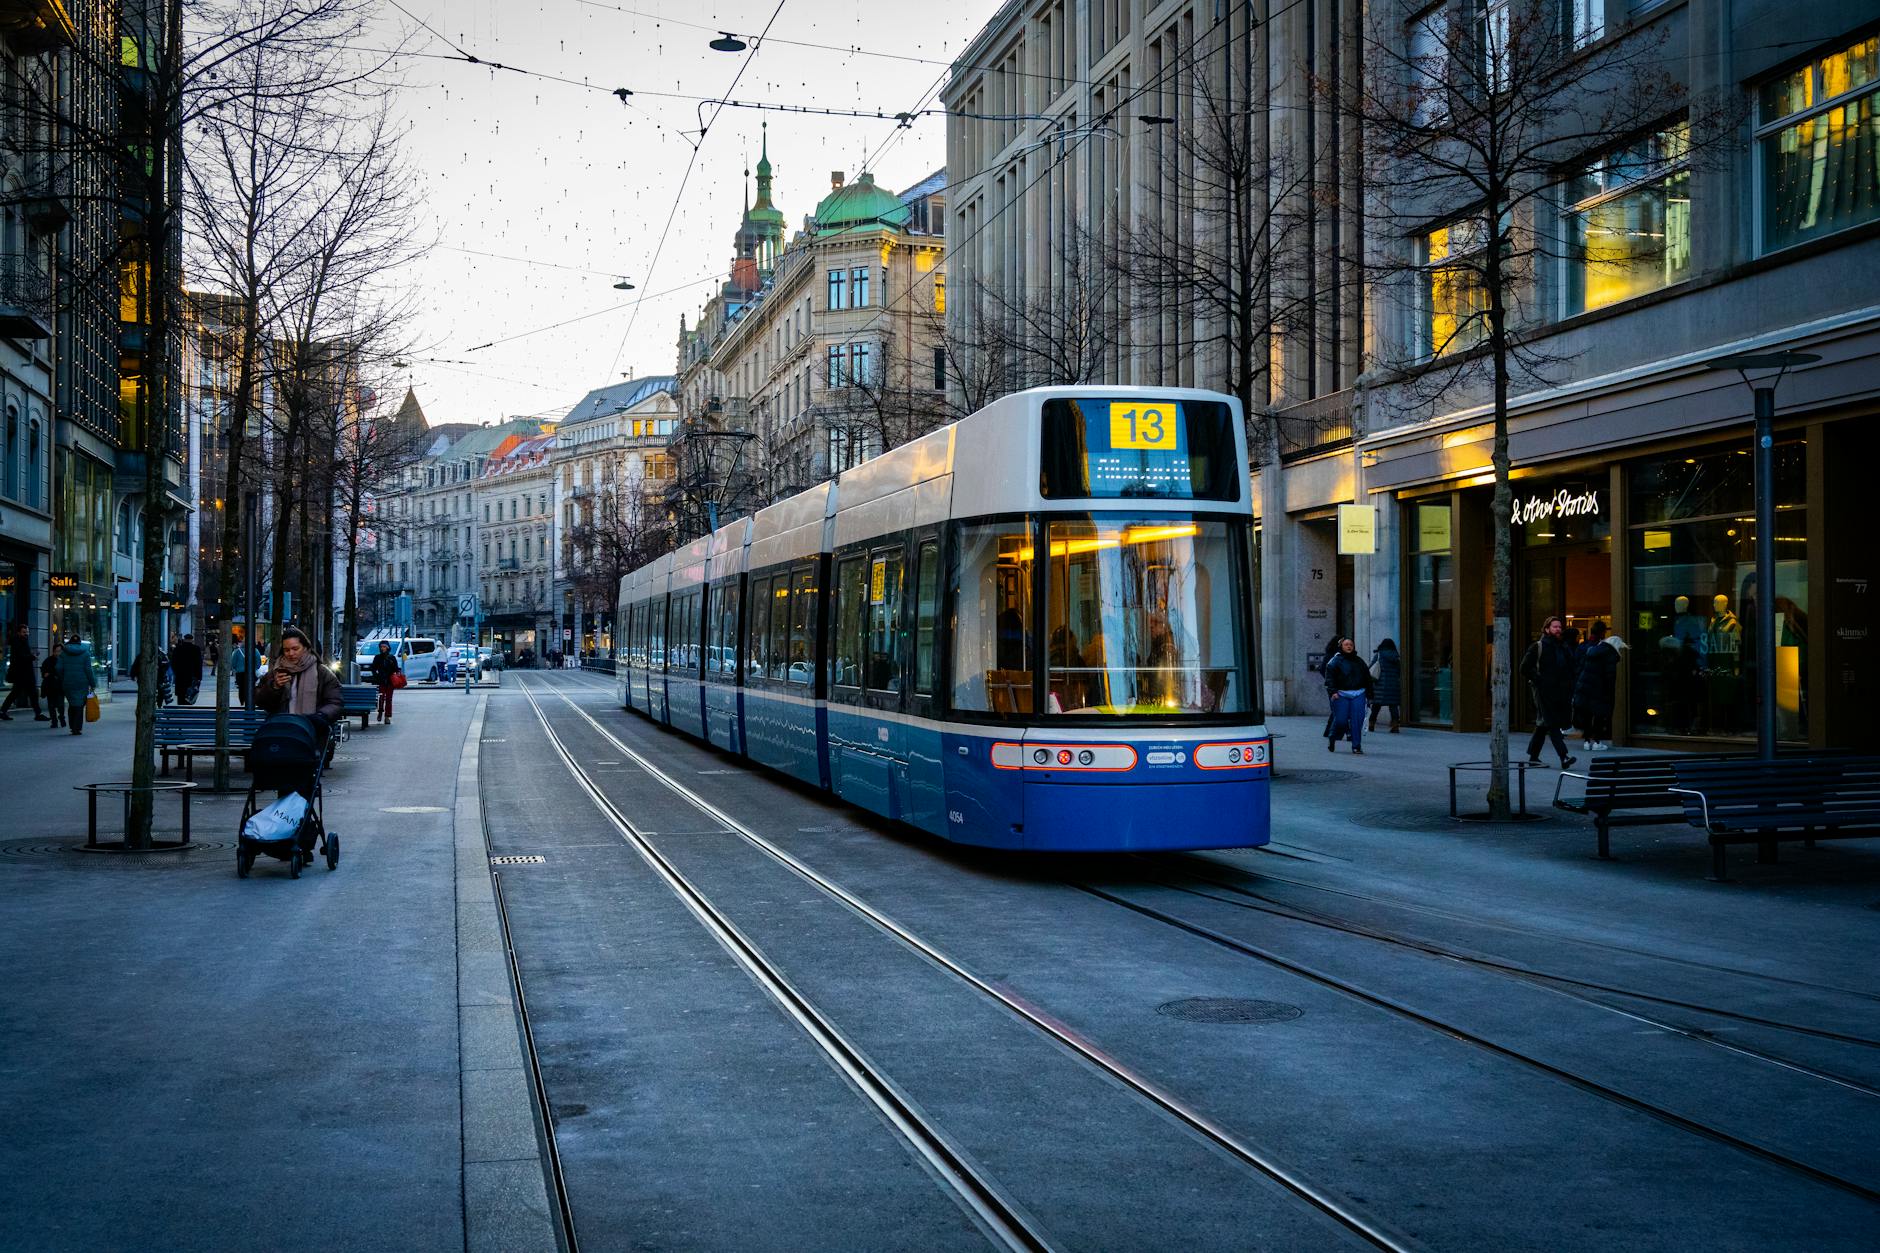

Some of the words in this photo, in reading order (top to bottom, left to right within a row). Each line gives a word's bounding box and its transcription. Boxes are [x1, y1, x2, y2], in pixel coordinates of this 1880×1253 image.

[1122, 409, 1165, 443] 13
[1511, 499, 1523, 525] &
[1558, 489, 1599, 518] Stories
[51, 576, 78, 587] Salt.
[1311, 568, 1323, 580] 75
[1855, 583, 1868, 593] 77
[1699, 632, 1738, 655] SALE
